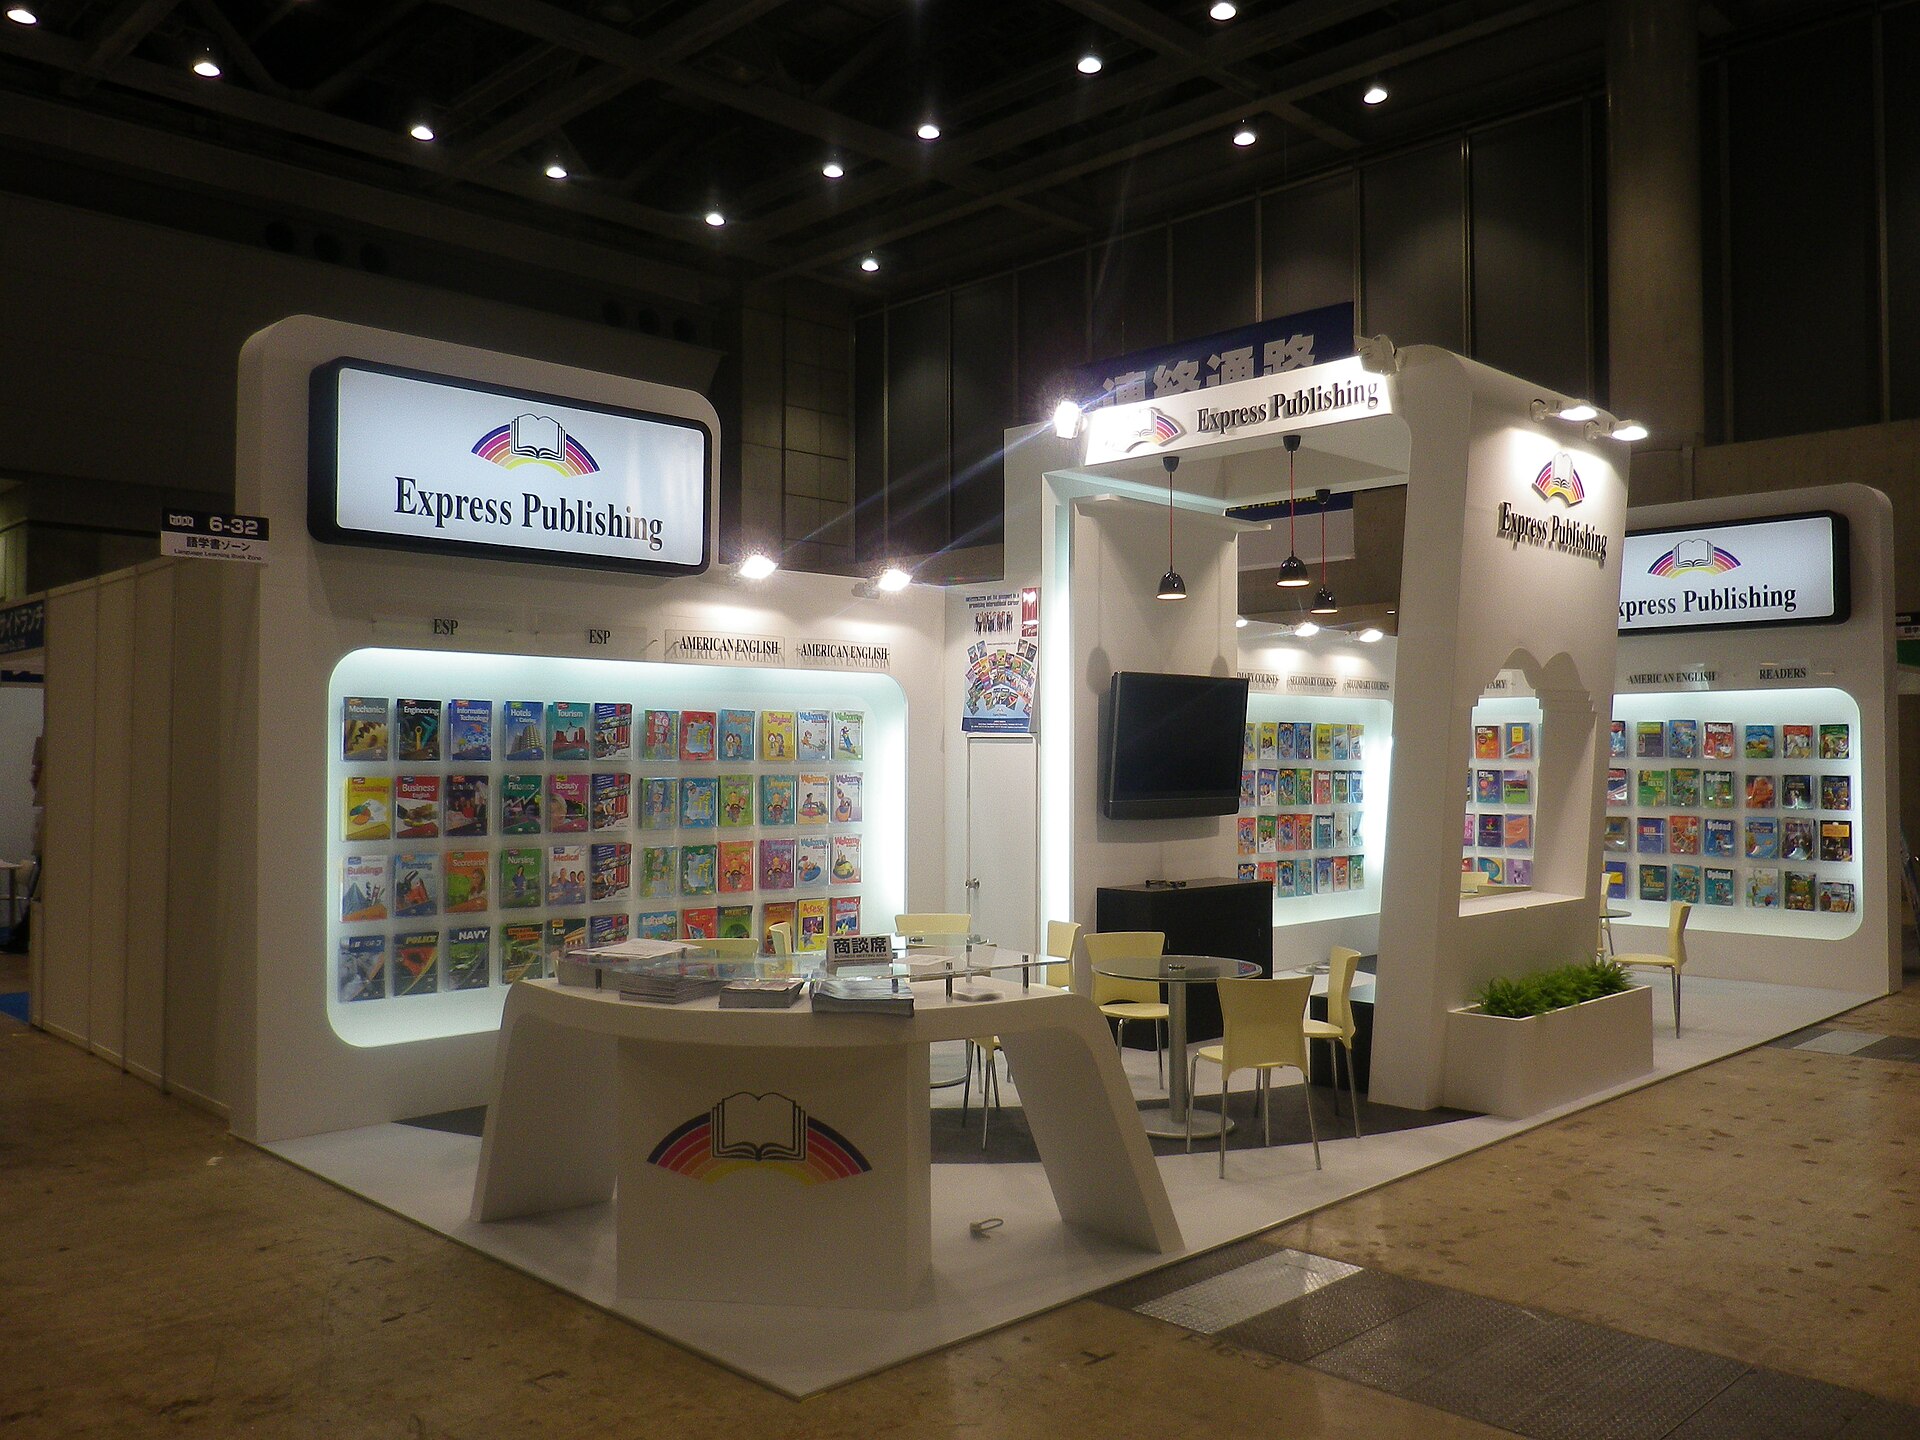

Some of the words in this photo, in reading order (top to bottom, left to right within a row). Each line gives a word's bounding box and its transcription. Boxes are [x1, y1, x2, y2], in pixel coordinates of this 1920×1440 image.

[1197, 402, 1267, 434] Express
[1273, 380, 1378, 417] Publishing
[394, 476, 512, 528] Express
[521, 493, 664, 551] Publishing
[209, 516, 259, 536] 6-32
[1501, 501, 1548, 541] Express
[1551, 514, 1608, 560] Publishing
[186, 536, 251, 552] 語学書ゾーン
[1618, 594, 1677, 623] xpress
[1683, 584, 1797, 613] Publishing
[433, 618, 458, 635] ESP
[589, 629, 611, 645] ESP
[679, 635, 735, 652] AMERICAN
[736, 638, 779, 655] ENGLISH
[800, 643, 848, 658] AMERICAN
[849, 644, 889, 661] ENGLISH
[1627, 672, 1675, 685] AMERICAN
[1676, 671, 1715, 683] ENGLISH
[1759, 667, 1806, 680] READERS
[404, 706, 439, 715] Engineering
[457, 707, 489, 715] Information
[510, 709, 531, 717] Hotels
[557, 709, 583, 718] Tourism
[402, 784, 435, 792] Business
[556, 782, 579, 791] Beauty
[507, 856, 535, 866] Nursing
[553, 853, 579, 862] Medical
[347, 866, 384, 875] Buildings
[803, 904, 825, 914] Access
[459, 930, 488, 940] NAVY
[552, 927, 565, 936] Law
[832, 936, 887, 954] 商談席
